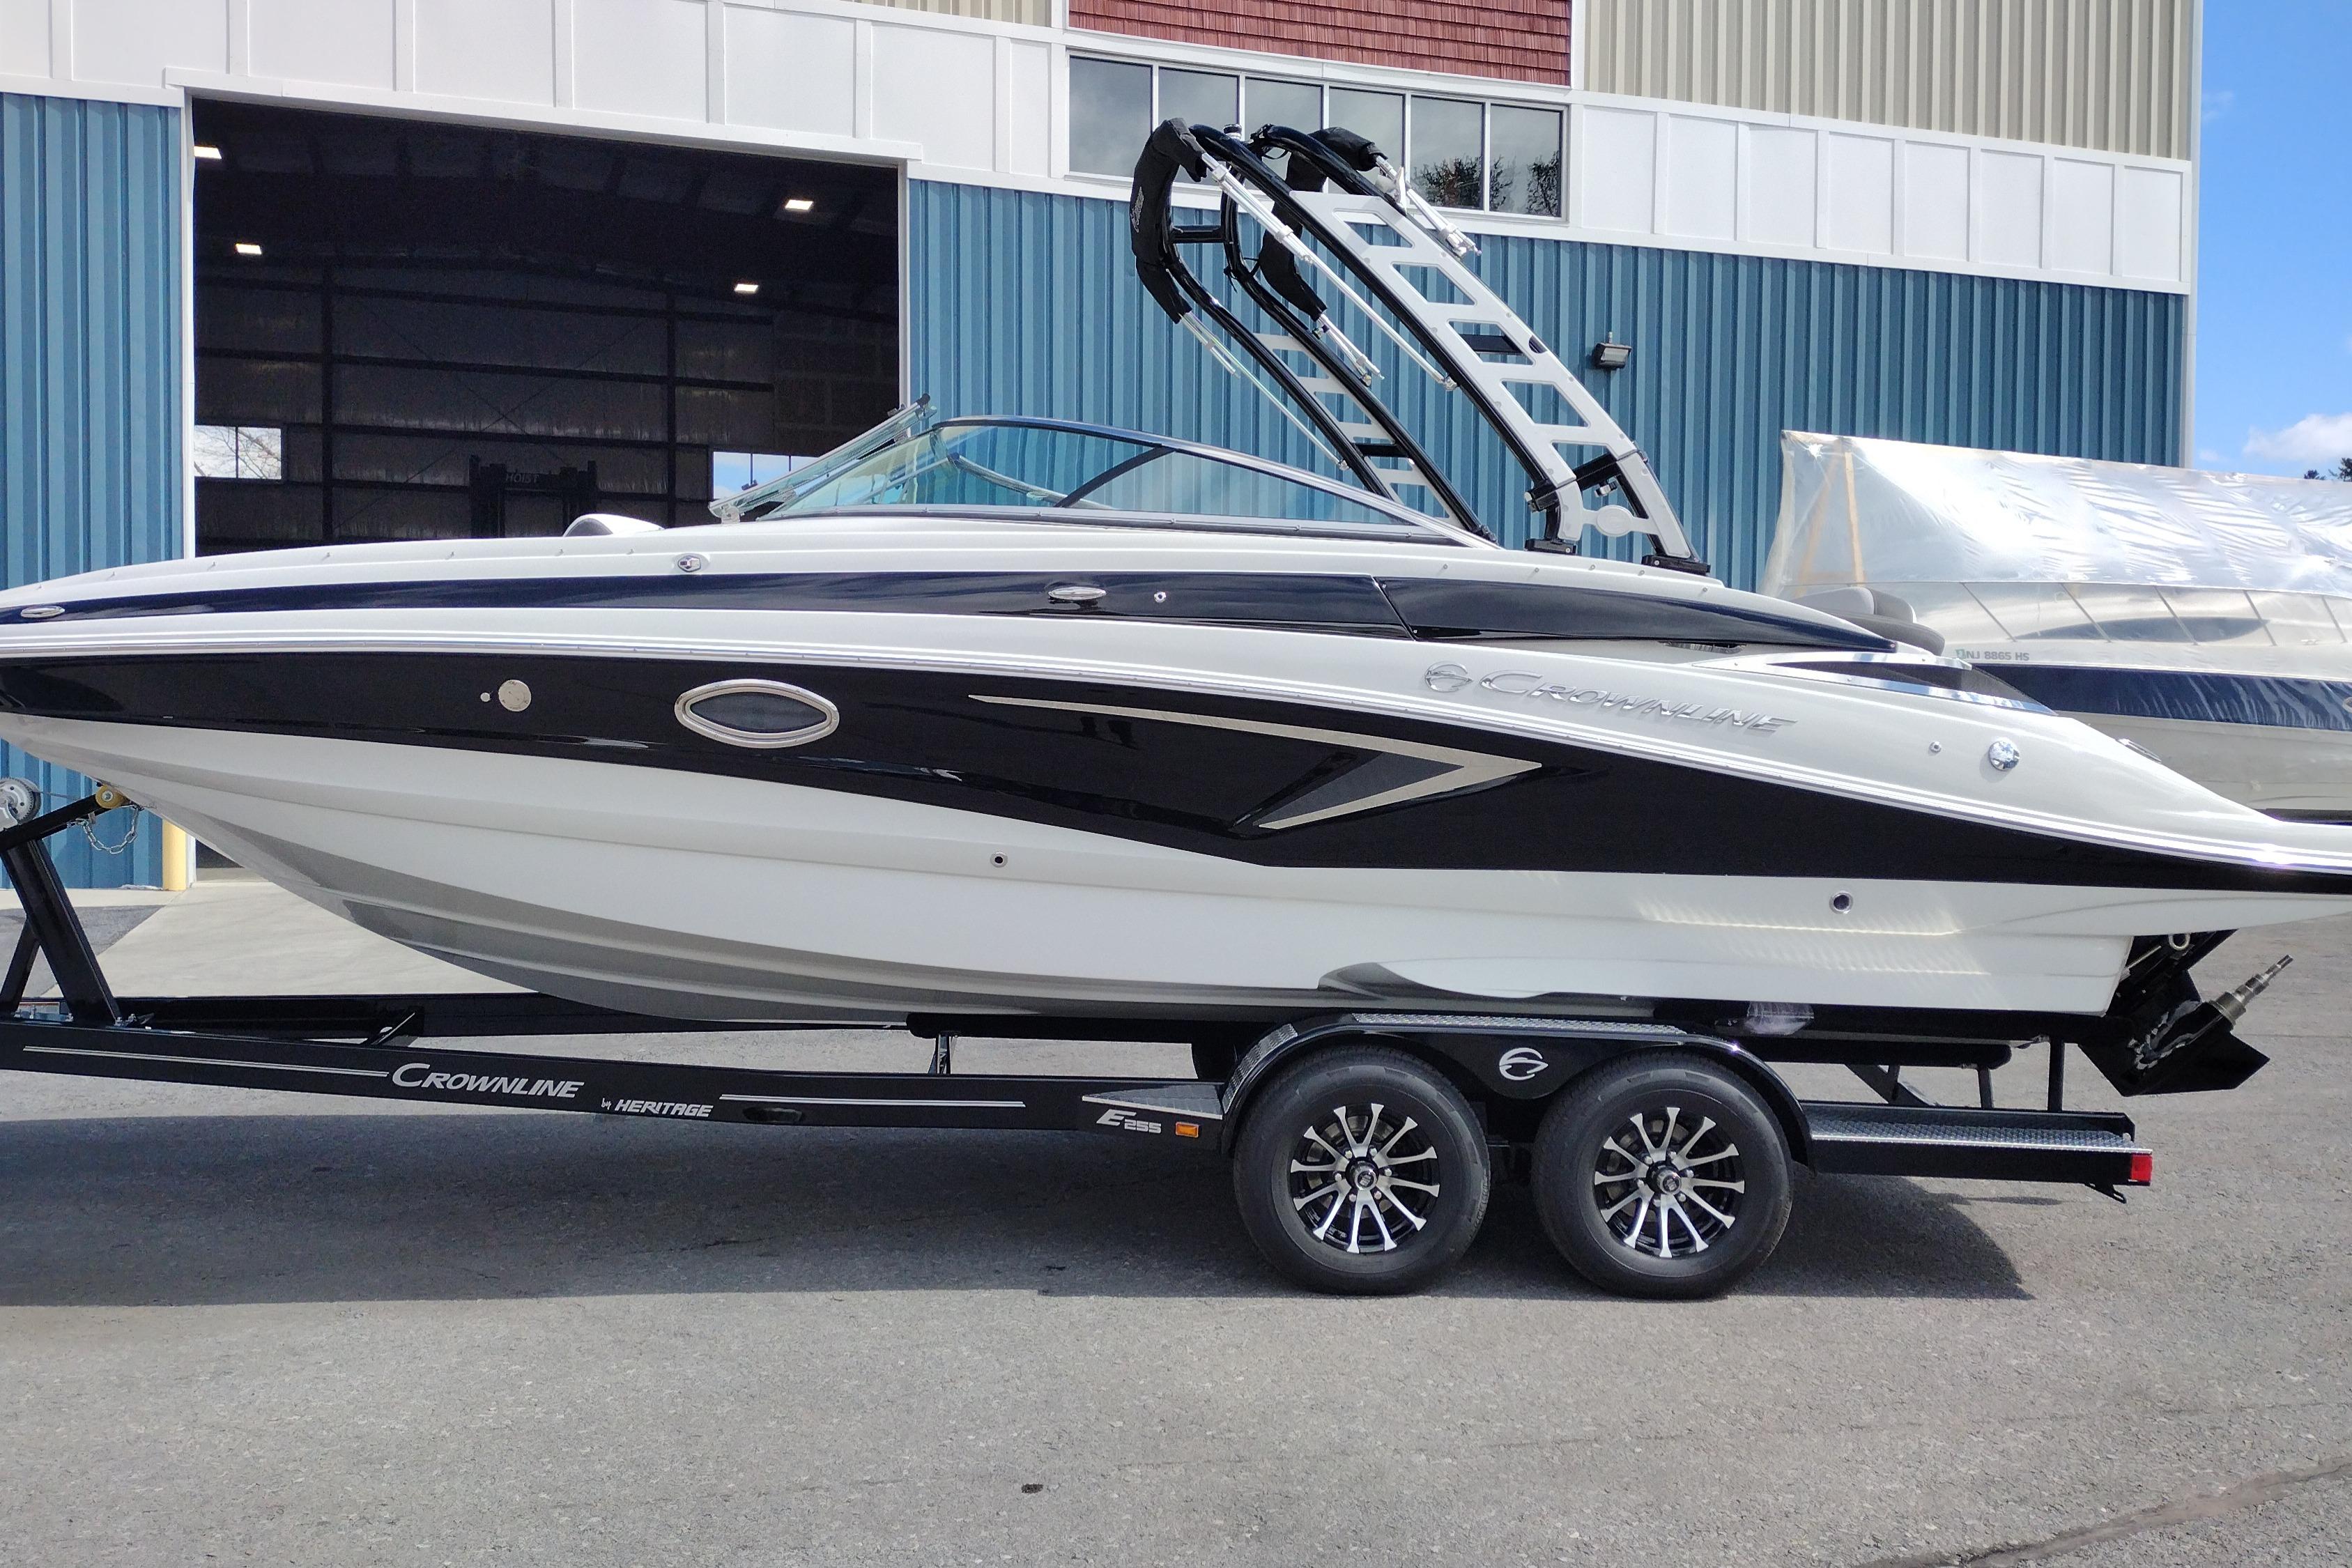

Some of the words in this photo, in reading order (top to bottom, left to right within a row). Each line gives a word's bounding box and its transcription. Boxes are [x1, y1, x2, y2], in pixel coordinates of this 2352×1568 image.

[1965, 650, 1981, 659] NJ
[1984, 651, 2012, 661] 8865
[2015, 652, 2030, 661] HS
[1479, 670, 1799, 734] CROWNLINE
[392, 1063, 585, 1098] CROWNLINE
[601, 1098, 613, 1109] by
[615, 1099, 714, 1117] HERITAGE
